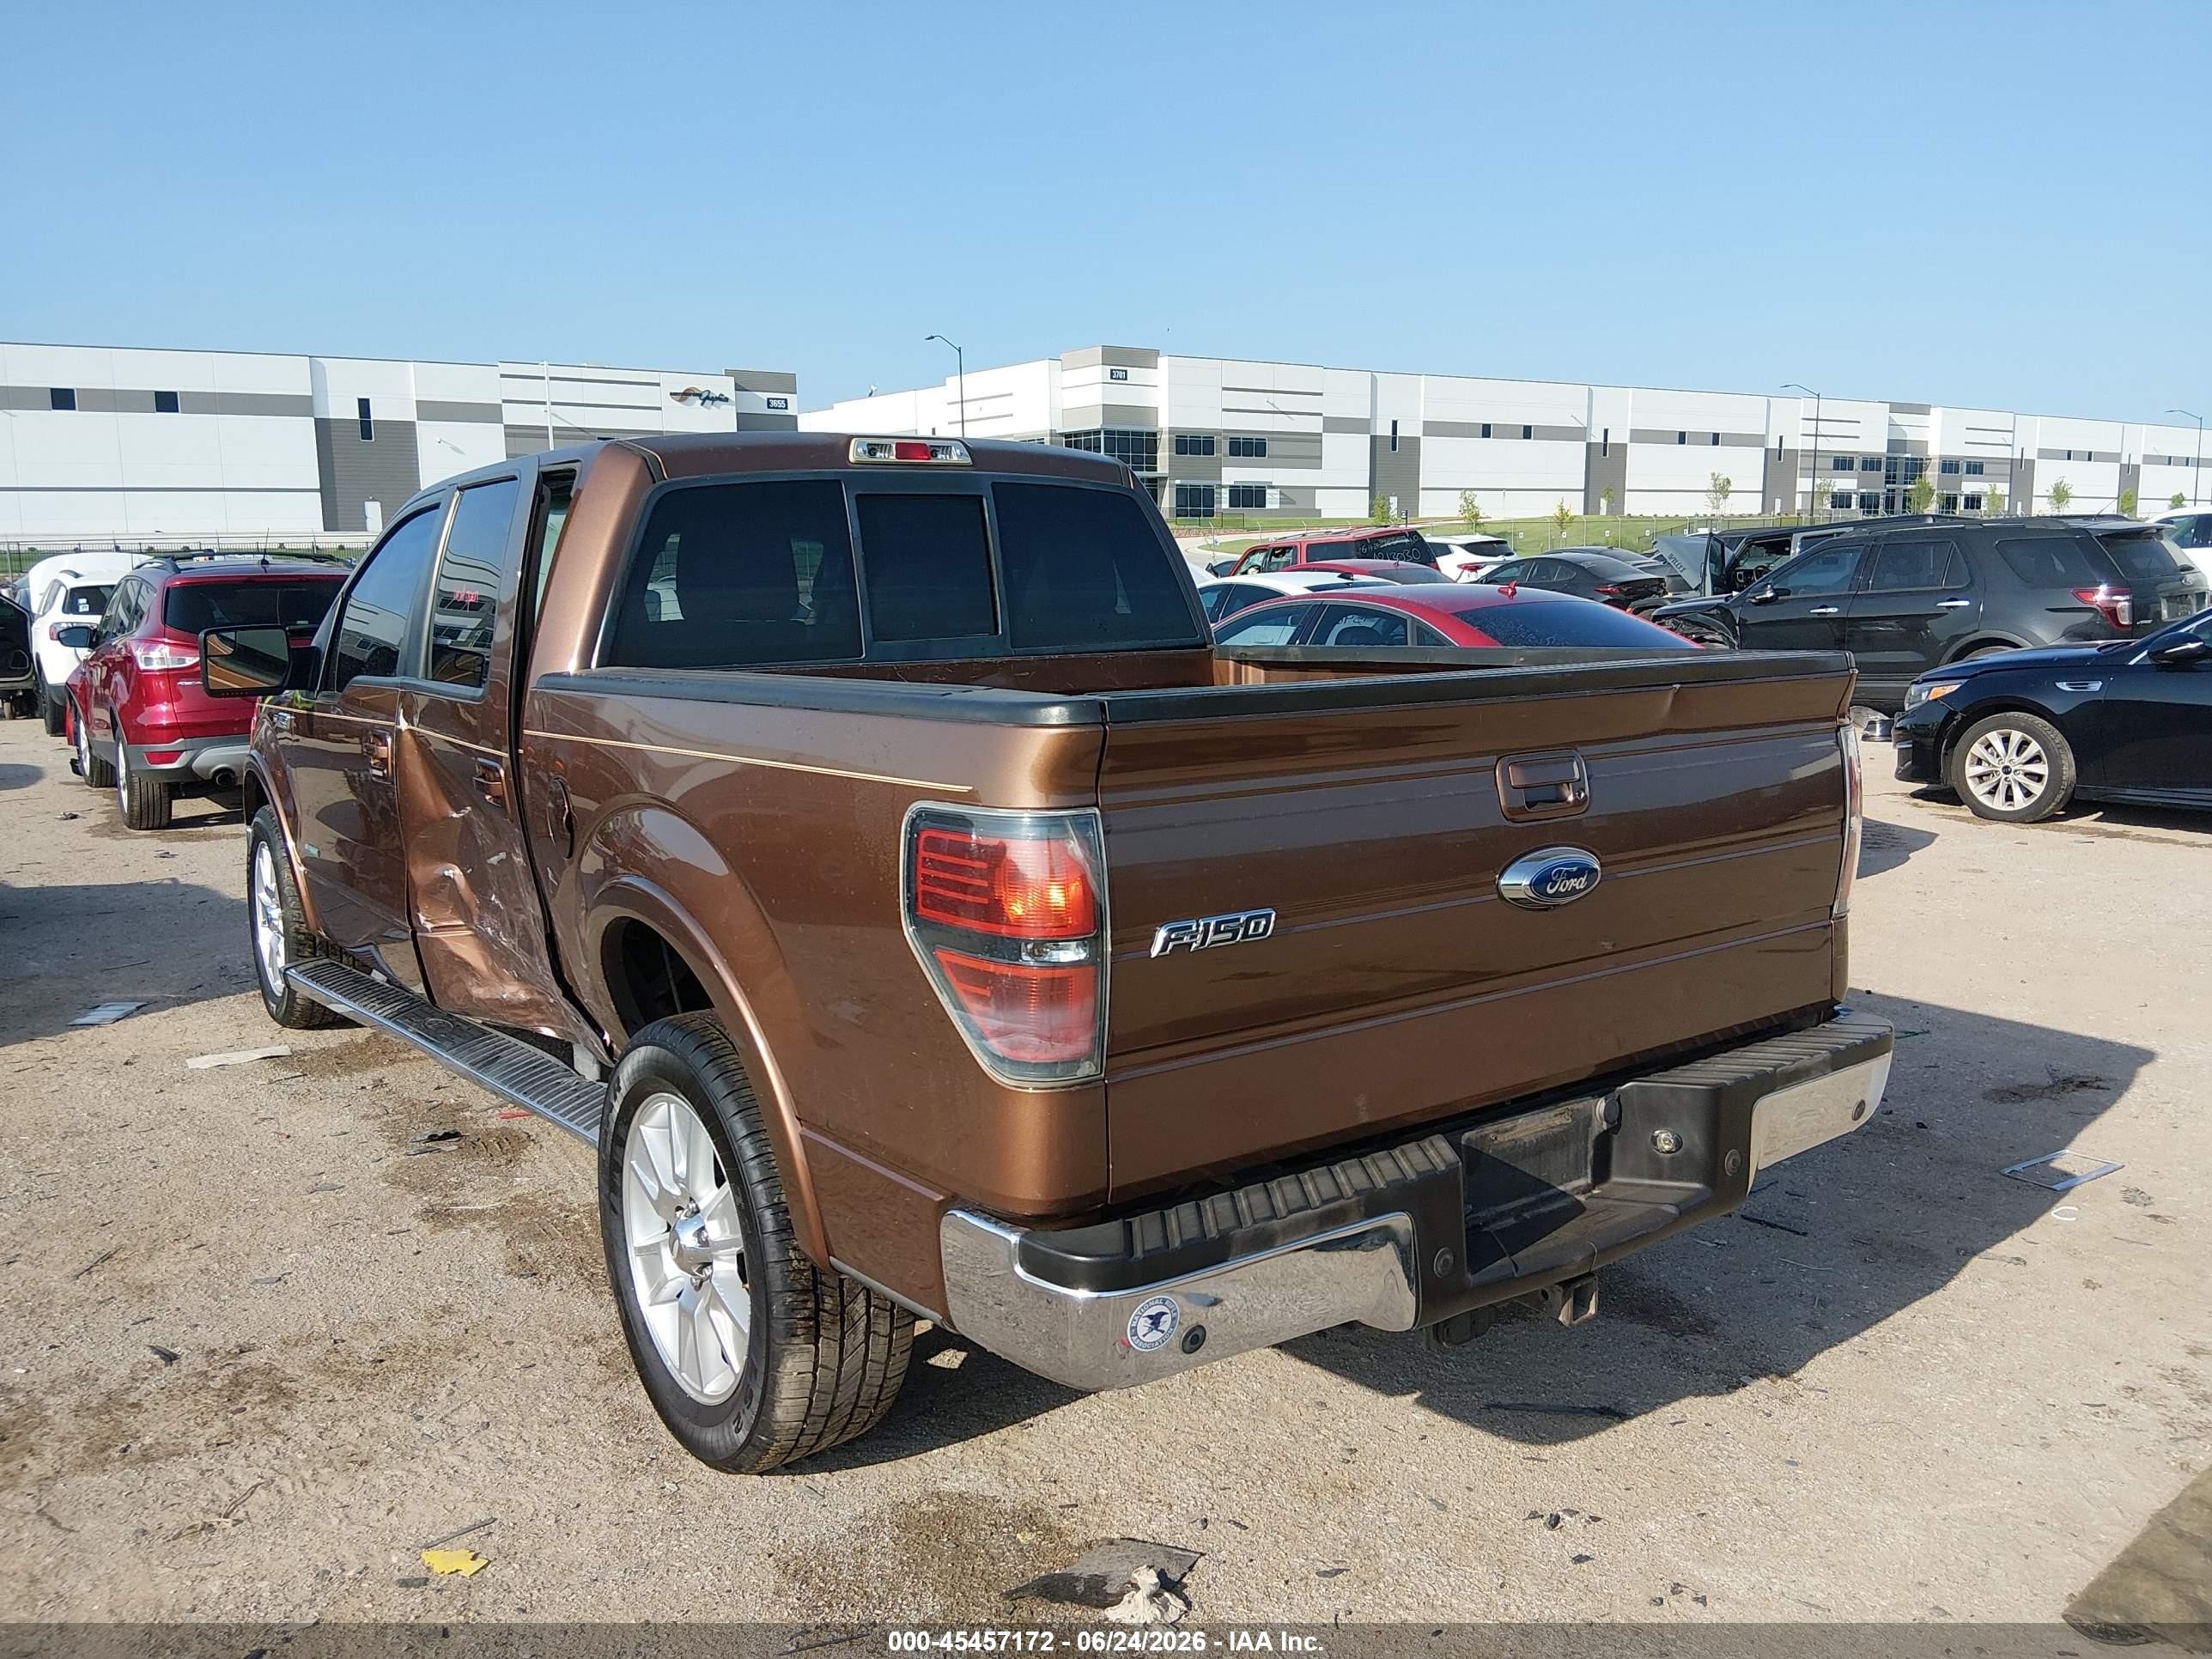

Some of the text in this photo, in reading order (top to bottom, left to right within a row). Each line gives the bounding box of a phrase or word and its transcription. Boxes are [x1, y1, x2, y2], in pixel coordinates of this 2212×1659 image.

[1112, 370, 1126, 380] 3701
[769, 398, 787, 409] 3655
[1546, 866, 1588, 894] Ford
[1150, 907, 1277, 959] F-150
[1131, 1298, 1177, 1327] NATIONAL RIFLE
[1131, 1328, 1174, 1349] ASSOCIATION
